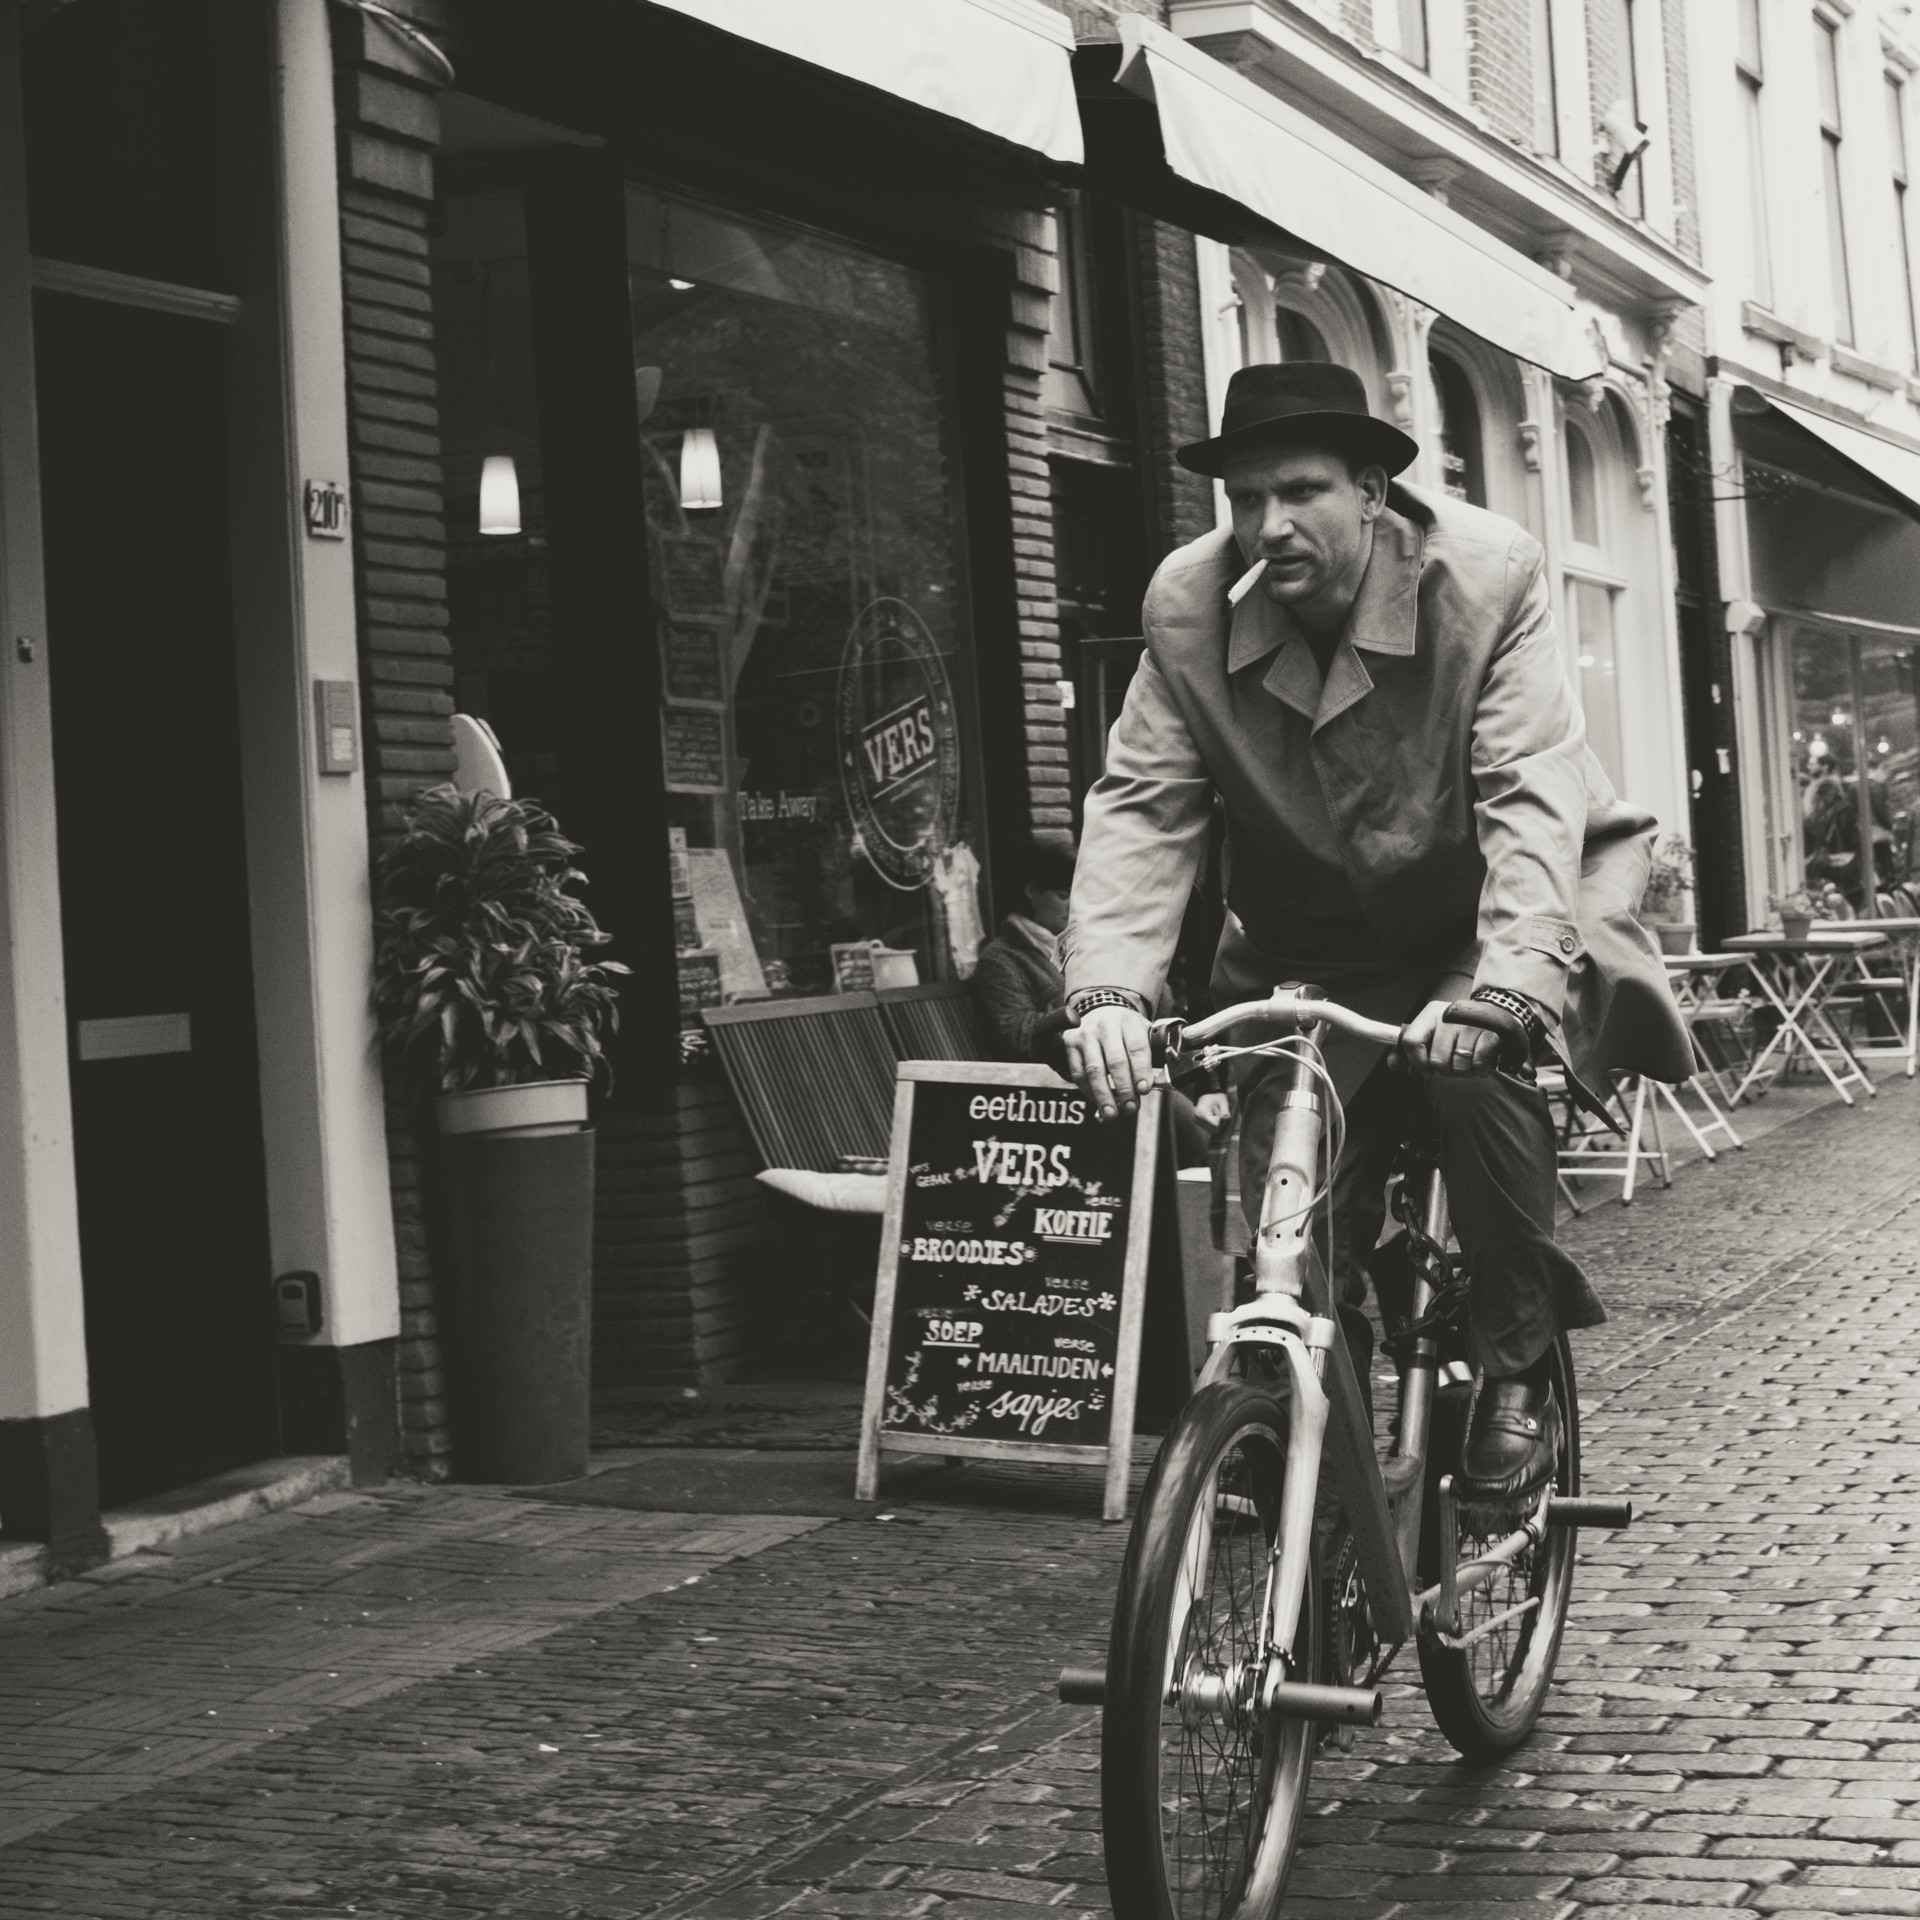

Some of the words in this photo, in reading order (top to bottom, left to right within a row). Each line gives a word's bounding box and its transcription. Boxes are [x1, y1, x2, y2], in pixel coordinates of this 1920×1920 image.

[864, 706, 935, 784] VERS
[737, 790, 775, 820] Take
[777, 789, 817, 823] Away
[969, 1090, 1086, 1124] eethuis
[972, 1140, 1071, 1187] VERS
[1033, 1208, 1113, 1239] KOFFIE
[911, 1238, 1025, 1266] BROODJES
[981, 1290, 1098, 1317] SALADES
[925, 1319, 984, 1342] SOEP
[1054, 1337, 1096, 1353] verse
[977, 1352, 1100, 1380] MAALTIJDEN
[986, 1387, 1085, 1435] sapjes
